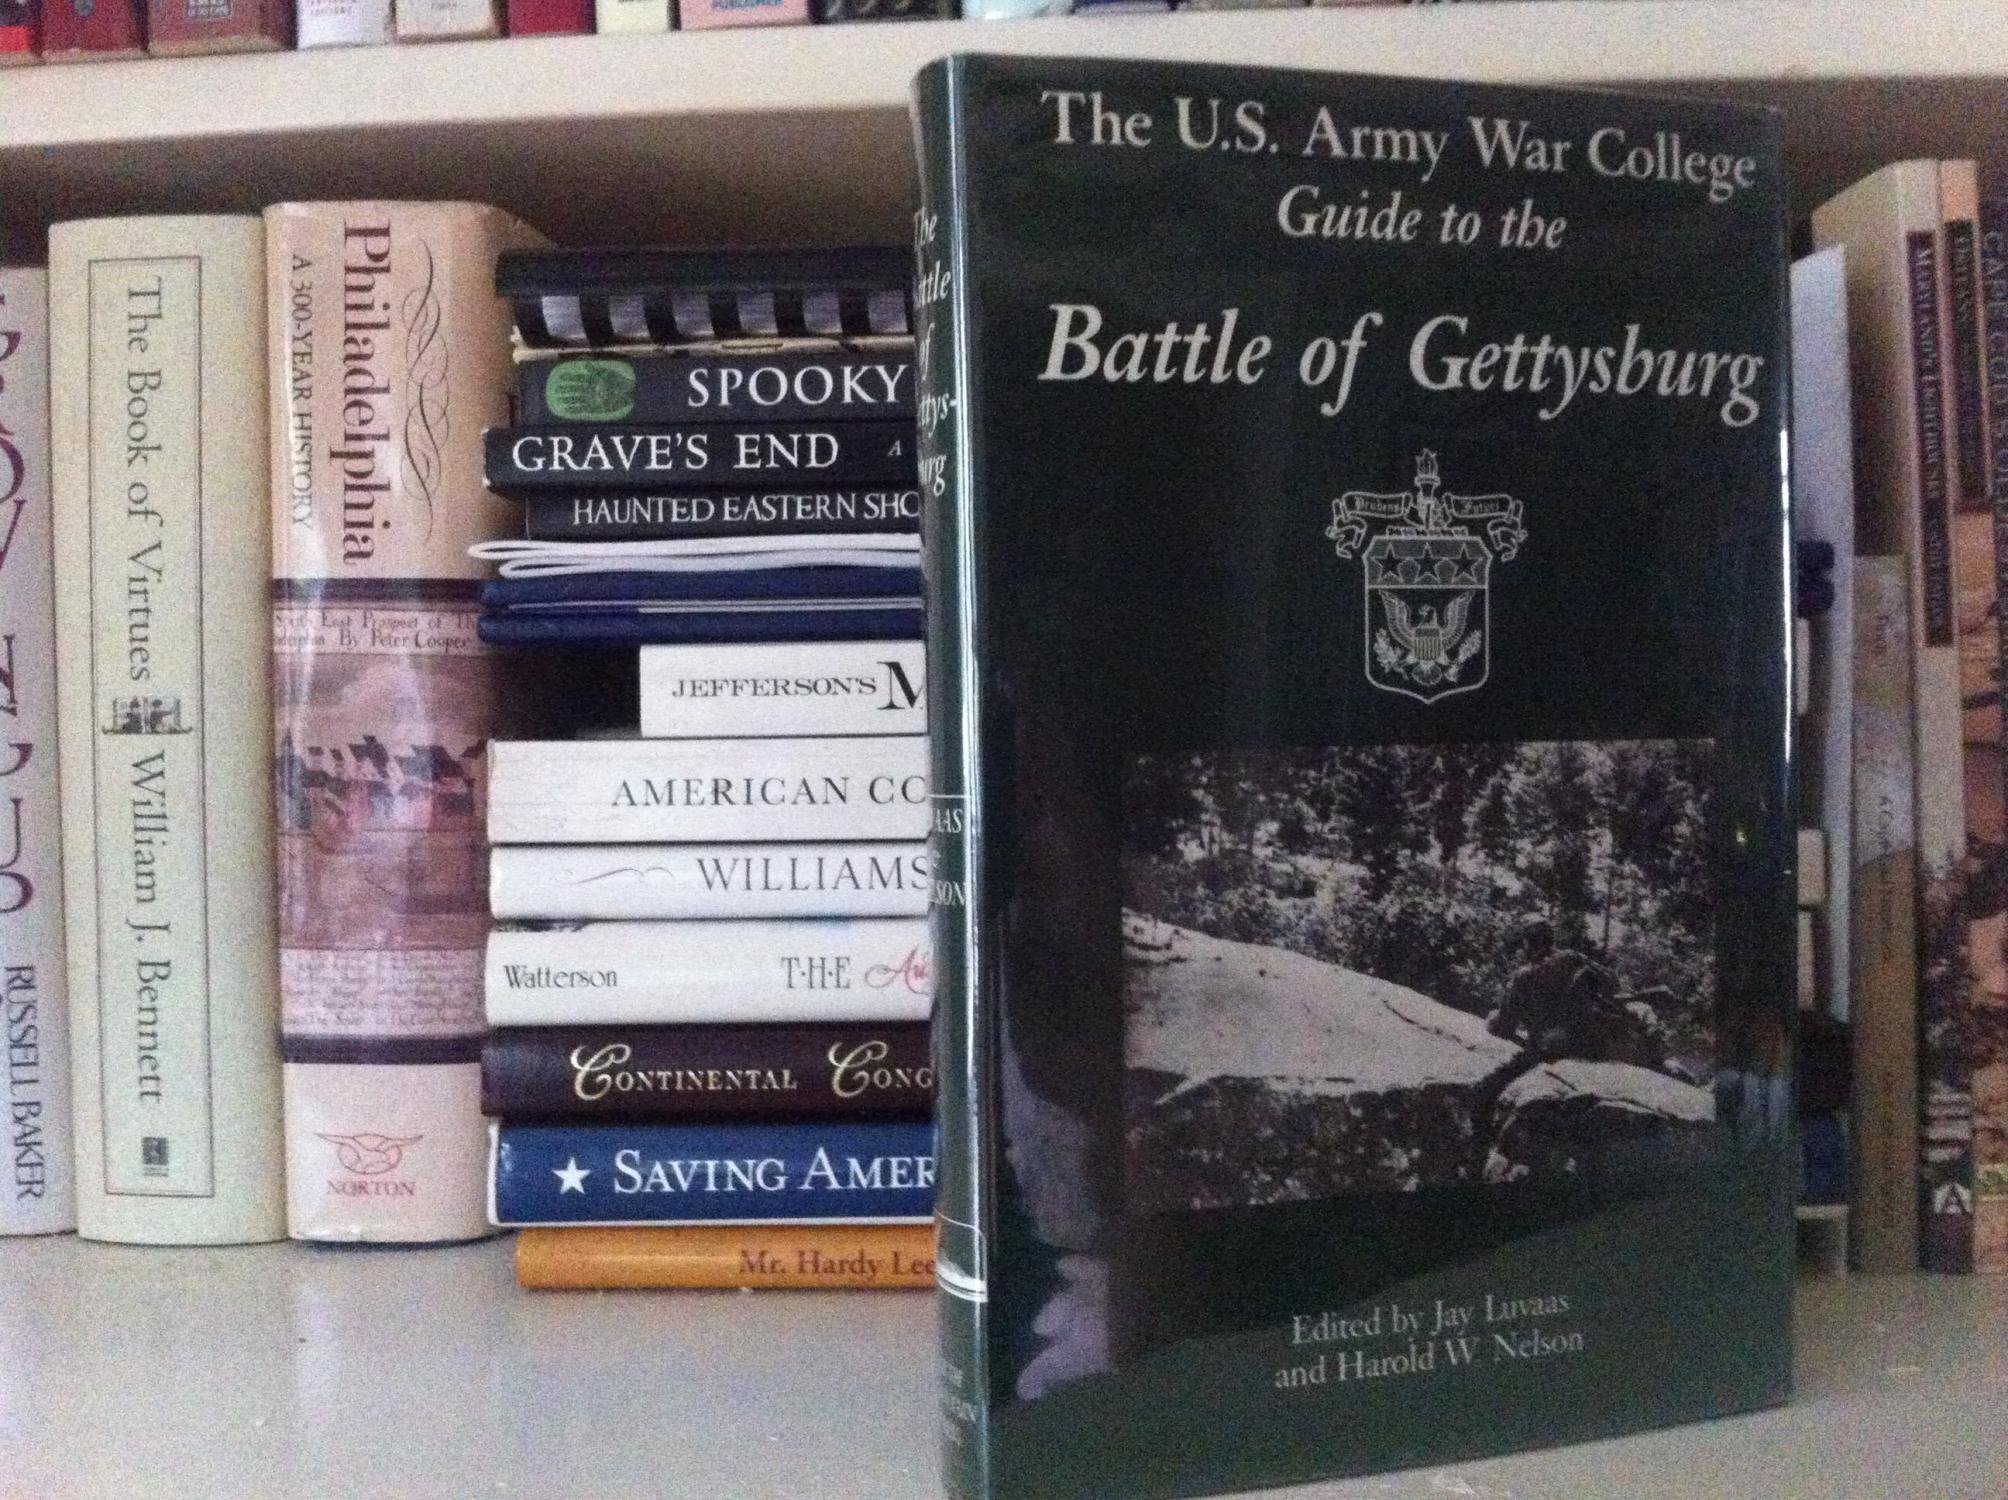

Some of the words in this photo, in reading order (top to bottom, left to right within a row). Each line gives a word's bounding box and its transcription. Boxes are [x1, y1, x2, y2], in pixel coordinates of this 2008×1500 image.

[1040, 90, 1152, 147] The
[1174, 97, 1279, 153] U.S.
[1302, 105, 1449, 182] Army
[1468, 116, 1572, 172] War
[1588, 127, 1756, 202] College
[1278, 185, 1422, 242] Guide
[1441, 204, 1482, 244] to
[1501, 199, 1567, 249] the
[292, 253, 313, 273] A
[128, 275, 162, 354] The
[292, 278, 313, 403] 300-YEAR
[330, 221, 390, 563] Philadelphia
[688, 364, 908, 408] SPOOKY
[1037, 303, 1272, 384] Battle
[1299, 312, 1384, 416] of
[1409, 315, 1764, 427] Gettysburg
[128, 370, 163, 465] Book
[292, 411, 314, 531] HISTORY
[512, 432, 709, 472] GRAVE'S
[733, 432, 839, 470] END
[888, 440, 902, 456] A
[128, 481, 163, 528] of
[573, 497, 714, 526] HAUNTED
[723, 493, 857, 522] EASTERN
[129, 541, 163, 682] Virtues
[672, 676, 878, 699] JEFFERSON'S
[611, 776, 850, 807] AMERICAN
[131, 749, 169, 905] William
[697, 856, 928, 892] WILLIAMS
[126, 919, 170, 944] J.
[504, 963, 618, 989] Watterson
[6, 964, 41, 1097] RUSSELL
[137, 959, 172, 1104] Bennett
[570, 1043, 798, 1100] CONTINENTAL
[11, 1100, 46, 1200] BAKER
[614, 1148, 785, 1194] SAVING
[327, 1180, 415, 1197] NORTON
[739, 1250, 786, 1275] Mr.
[798, 1249, 879, 1281] Hardy
[1291, 1306, 1382, 1345] Edited
[1391, 1304, 1425, 1338] by
[1431, 1300, 1475, 1336] Jay
[1485, 1294, 1571, 1322] Luvaas
[1275, 1355, 1327, 1388] and
[1338, 1336, 1435, 1382] Harold
[1494, 1328, 1584, 1361] Nelson
